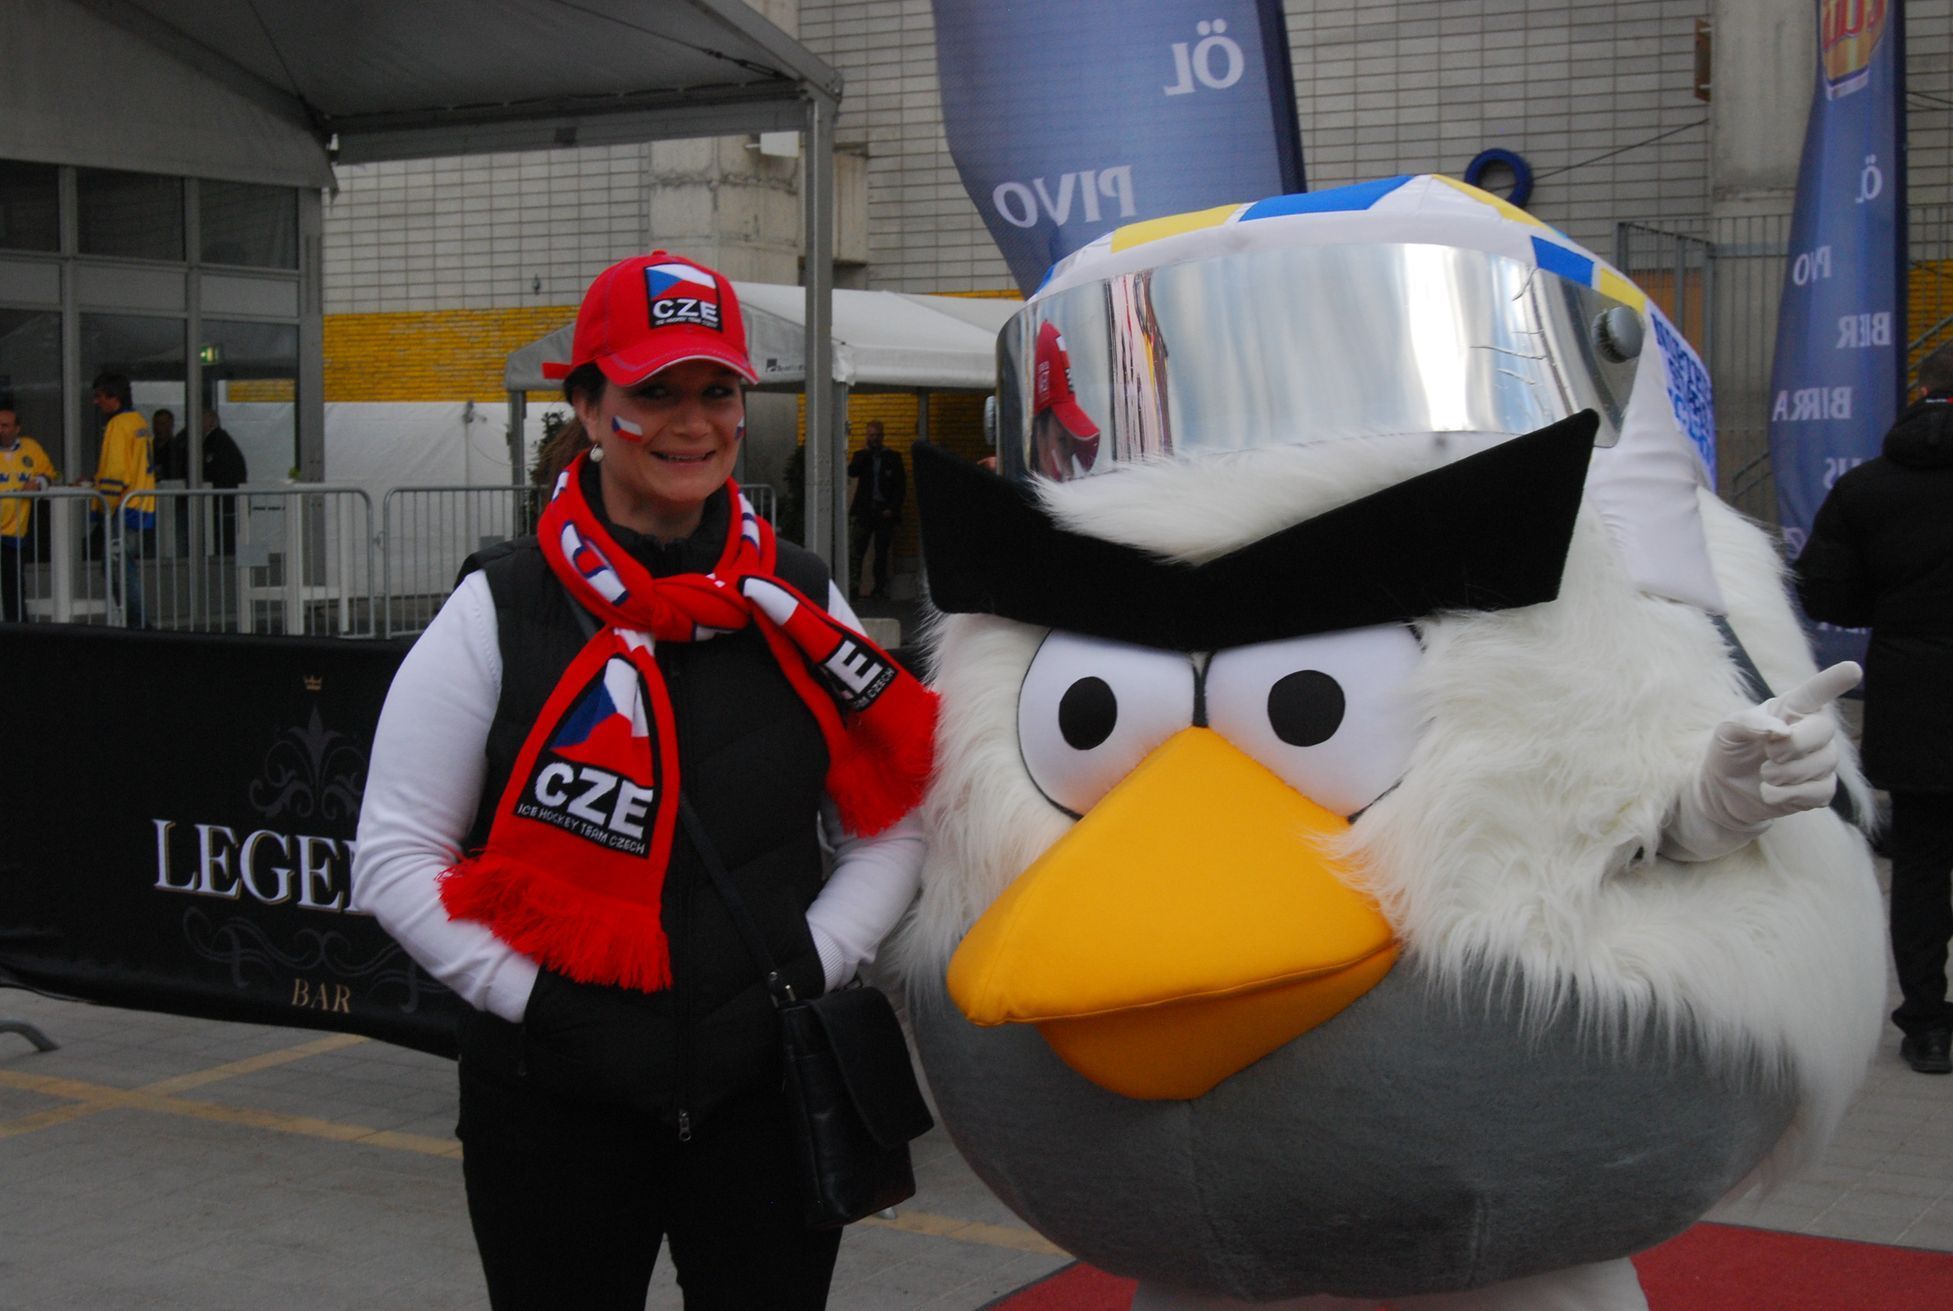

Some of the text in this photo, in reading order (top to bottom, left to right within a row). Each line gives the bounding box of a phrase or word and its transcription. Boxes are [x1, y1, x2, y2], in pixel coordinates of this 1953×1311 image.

[653, 299, 719, 322] CZE
[535, 762, 654, 839] CZE
[517, 803, 645, 854] ICE HOCKEY TEAM CZECH
[152, 819, 366, 915] LEGE
[291, 978, 351, 1013] BAR
